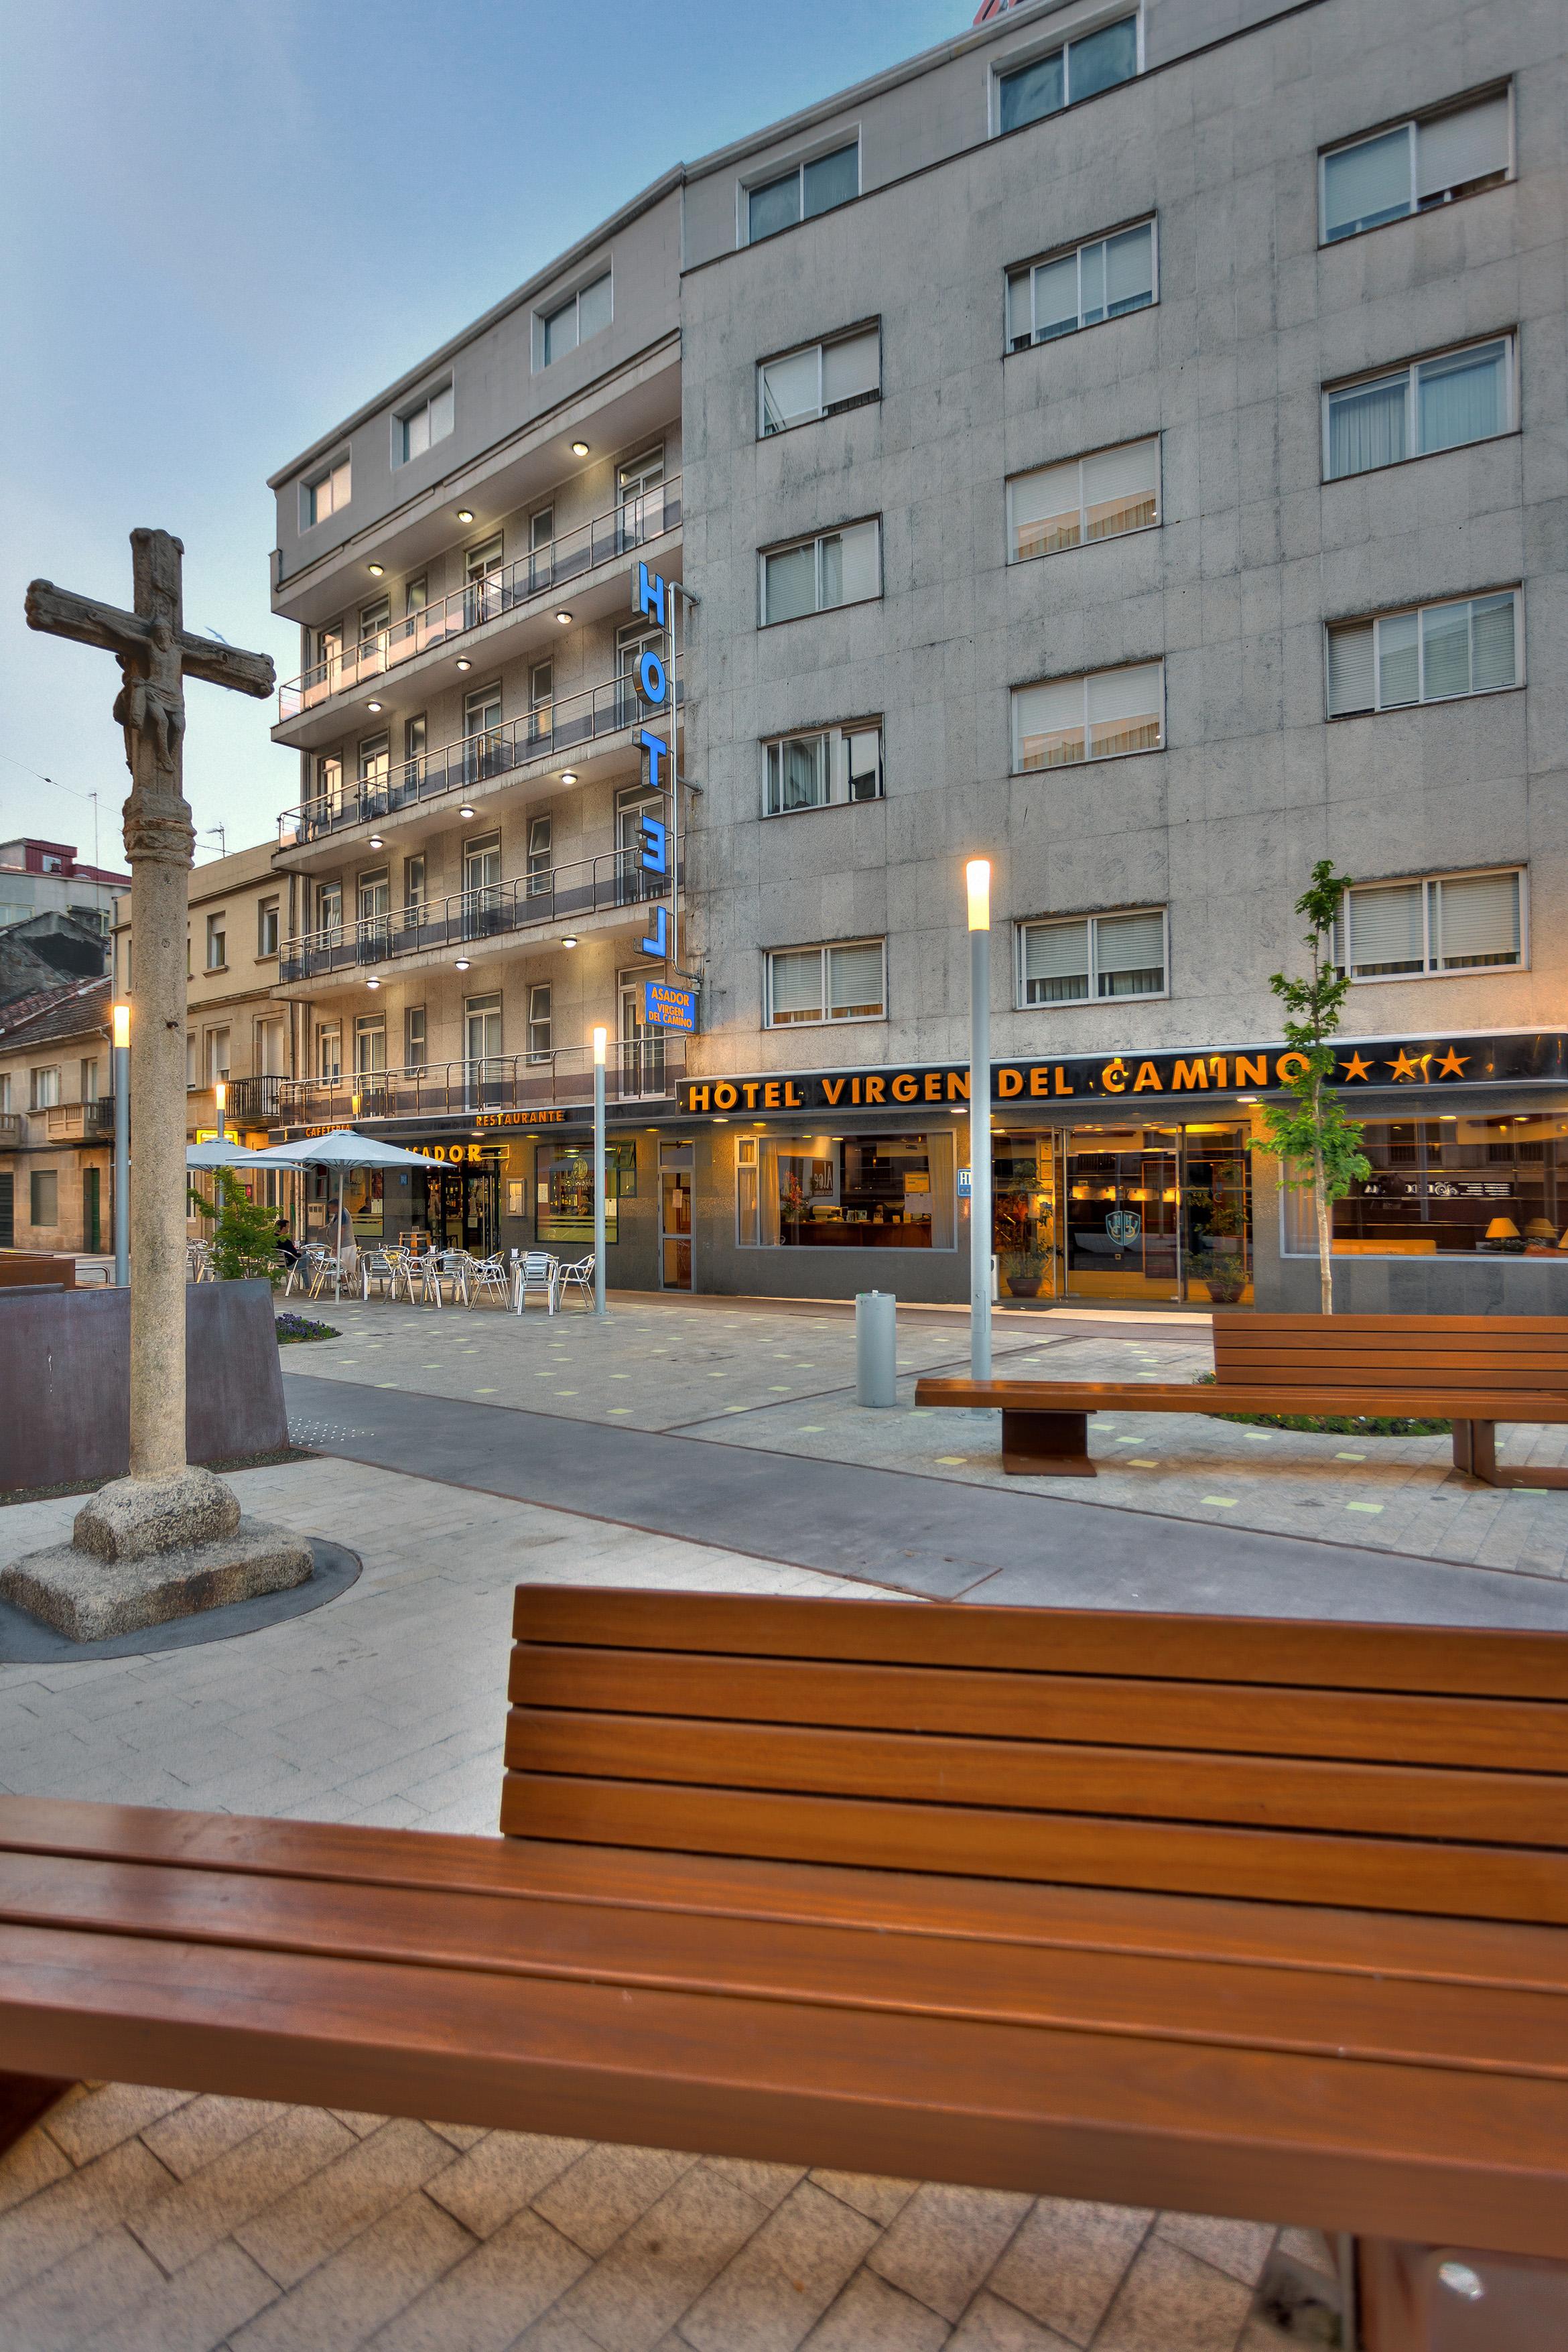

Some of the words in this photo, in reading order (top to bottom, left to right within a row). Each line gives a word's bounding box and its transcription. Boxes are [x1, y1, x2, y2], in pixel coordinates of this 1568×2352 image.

[651, 986, 690, 1006] ASADOR
[657, 1002, 683, 1017] VIRGEN
[649, 1010, 661, 1023] DEL
[663, 1013, 692, 1028] CAMINO
[689, 1081, 801, 1111] HOTEL
[822, 1071, 971, 1105] VIRGEN
[998, 1066, 1074, 1098] DEL
[1102, 1052, 1311, 1093] CAMINO
[476, 1110, 566, 1126] RESTAURANTE
